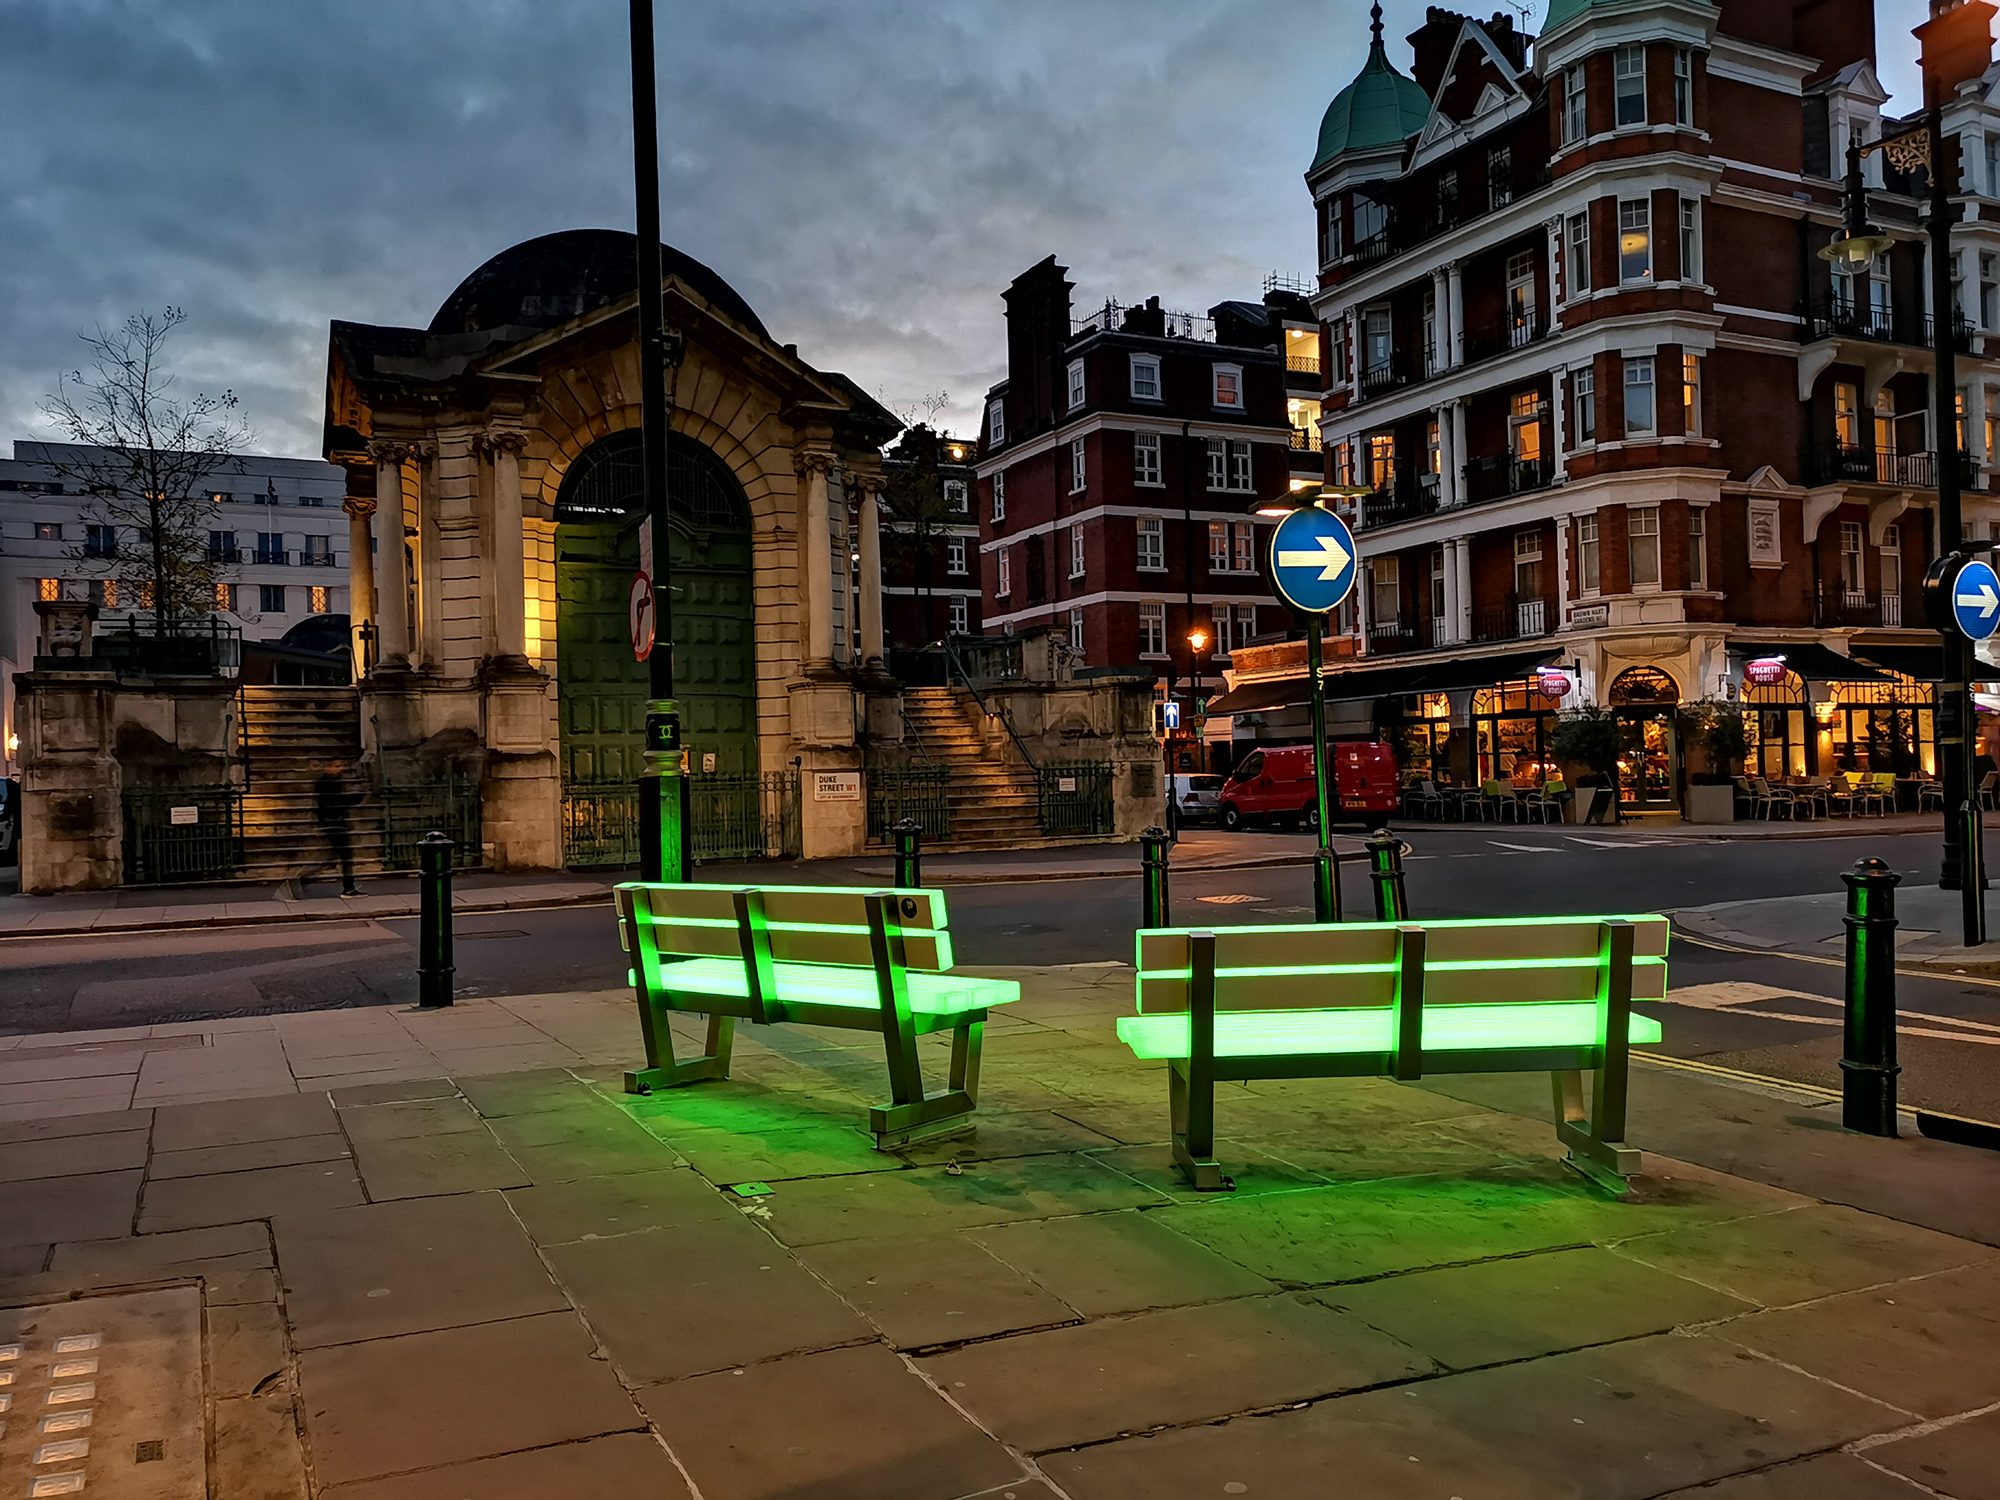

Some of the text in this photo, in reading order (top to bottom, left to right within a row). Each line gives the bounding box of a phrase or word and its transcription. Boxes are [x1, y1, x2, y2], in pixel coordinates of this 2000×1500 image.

[1749, 665, 1781, 675] SPAGHETTI
[1754, 674, 1775, 682] HOUSE
[1543, 679, 1568, 687] SPAGHETTI
[819, 775, 838, 784] DUKE
[819, 783, 857, 792] STREET W1
